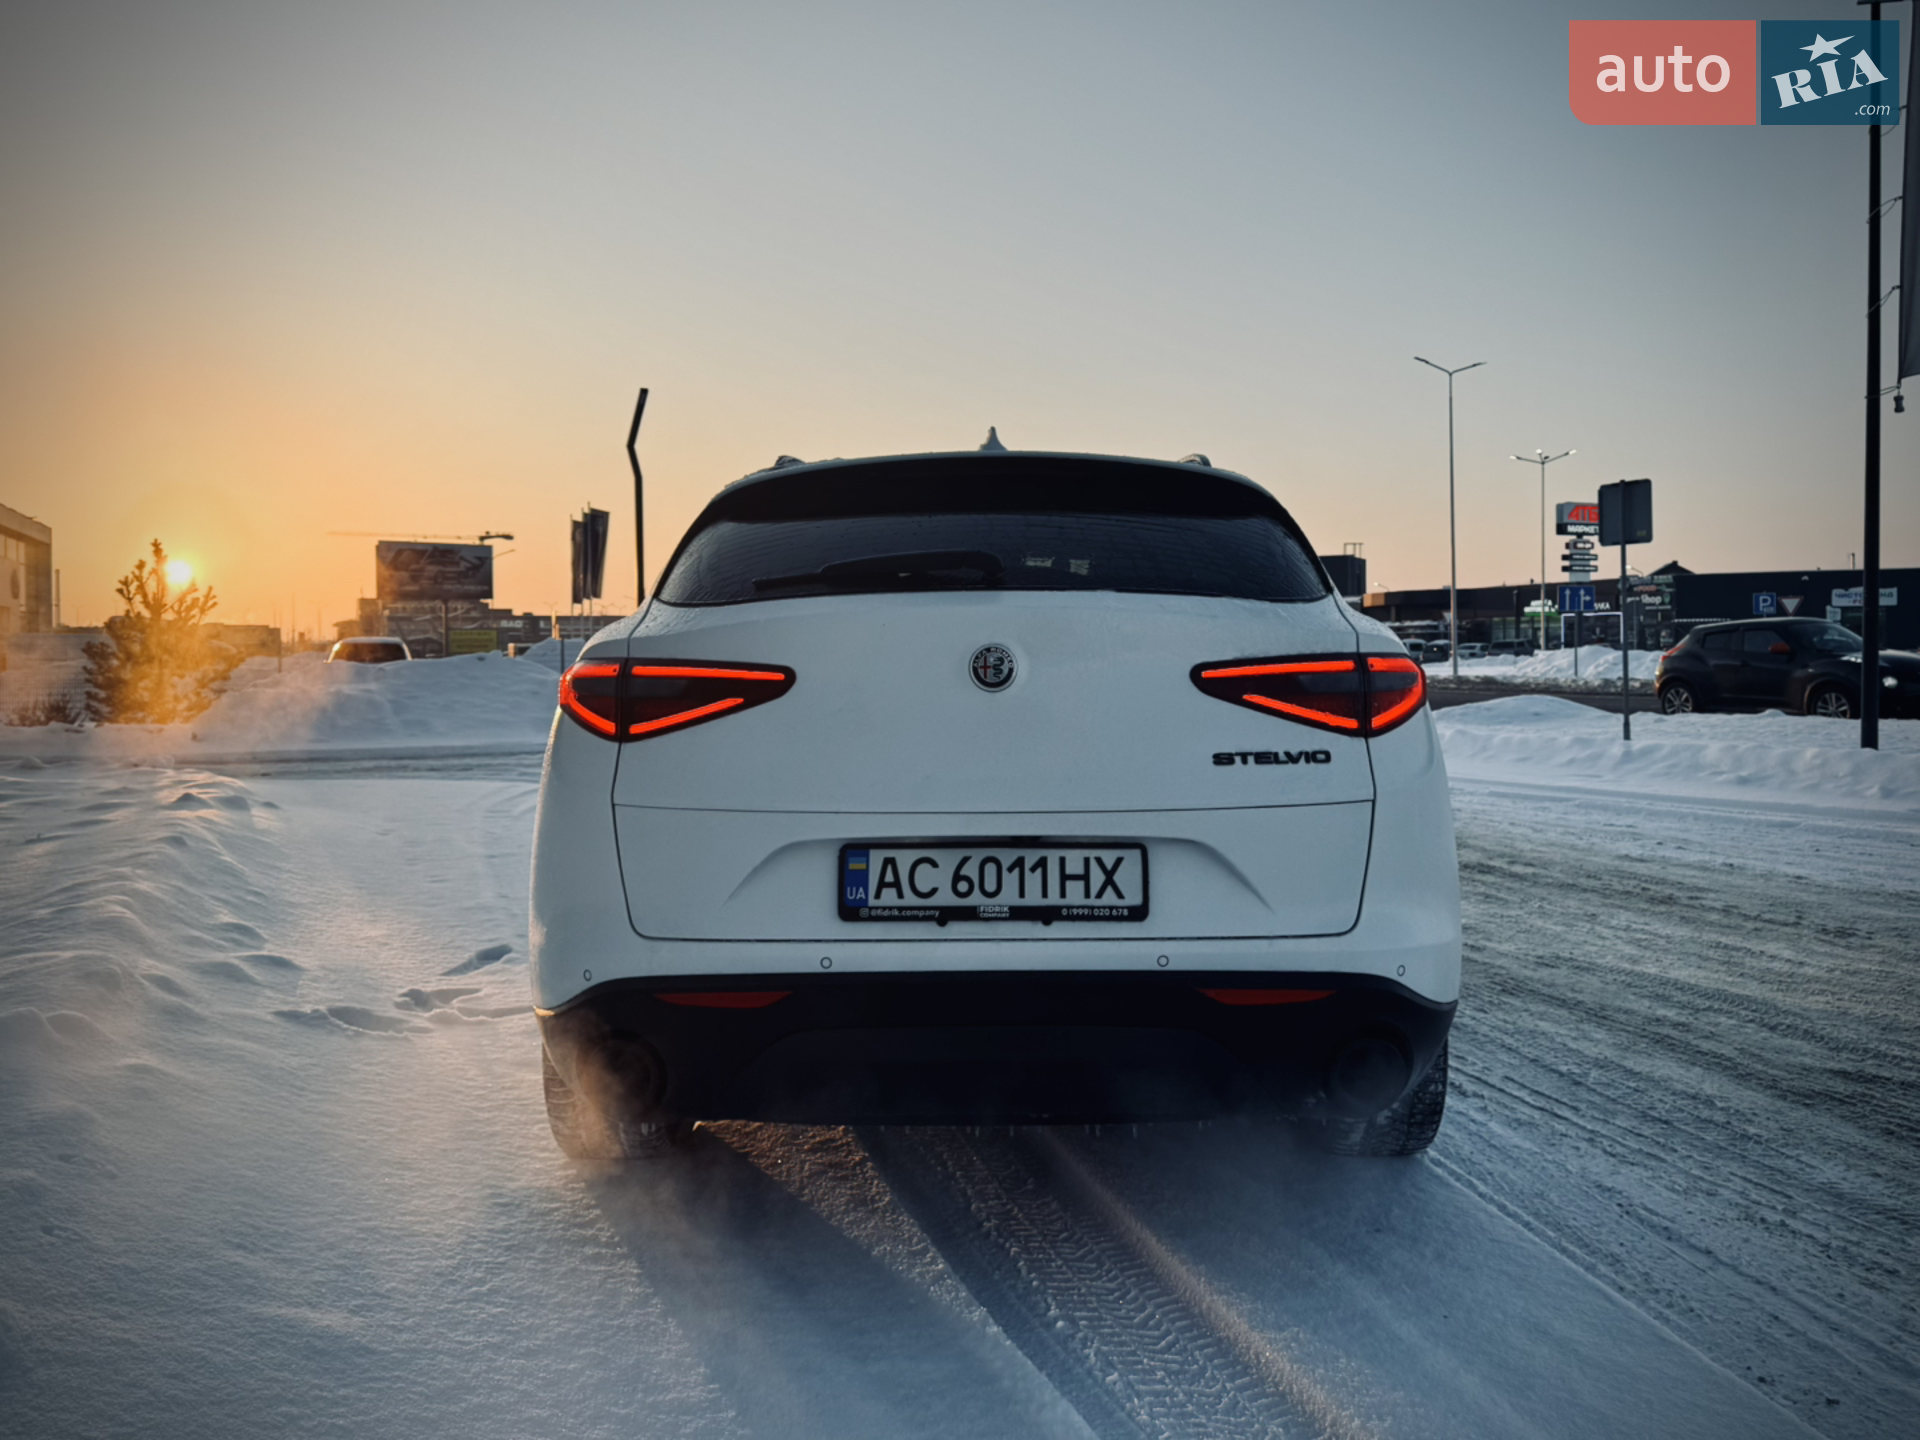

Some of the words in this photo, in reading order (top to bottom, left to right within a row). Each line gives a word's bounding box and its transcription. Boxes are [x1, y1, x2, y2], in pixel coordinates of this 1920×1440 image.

[1759, 595, 1772, 611] P
[1212, 750, 1331, 766] STELVIO
[873, 856, 940, 900] AC
[951, 855, 1048, 900] 6011
[1059, 856, 1125, 900] HX
[847, 887, 866, 900] UA
[980, 905, 1010, 913] FIDRIK
[1093, 907, 1110, 916] 020
[1111, 907, 1129, 917] 678
